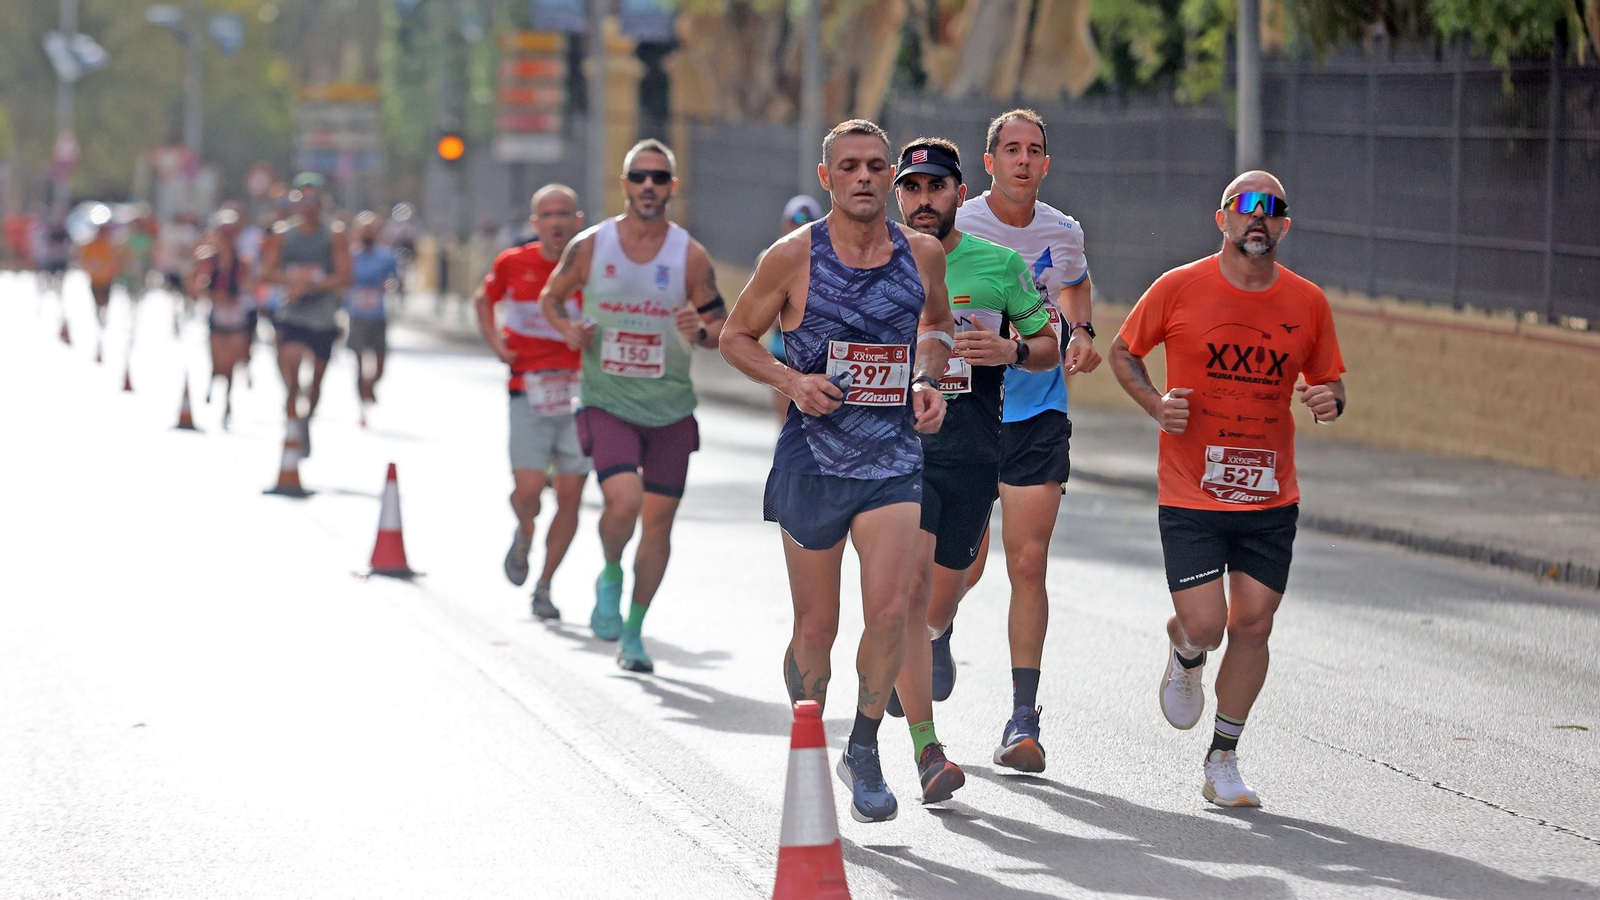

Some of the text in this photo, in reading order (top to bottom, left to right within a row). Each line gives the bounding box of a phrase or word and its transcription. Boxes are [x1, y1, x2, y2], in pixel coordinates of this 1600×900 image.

[618, 346, 650, 363] 150
[849, 364, 891, 386] 297
[1207, 372, 1233, 381] MEDIA
[1222, 467, 1264, 488] 527
